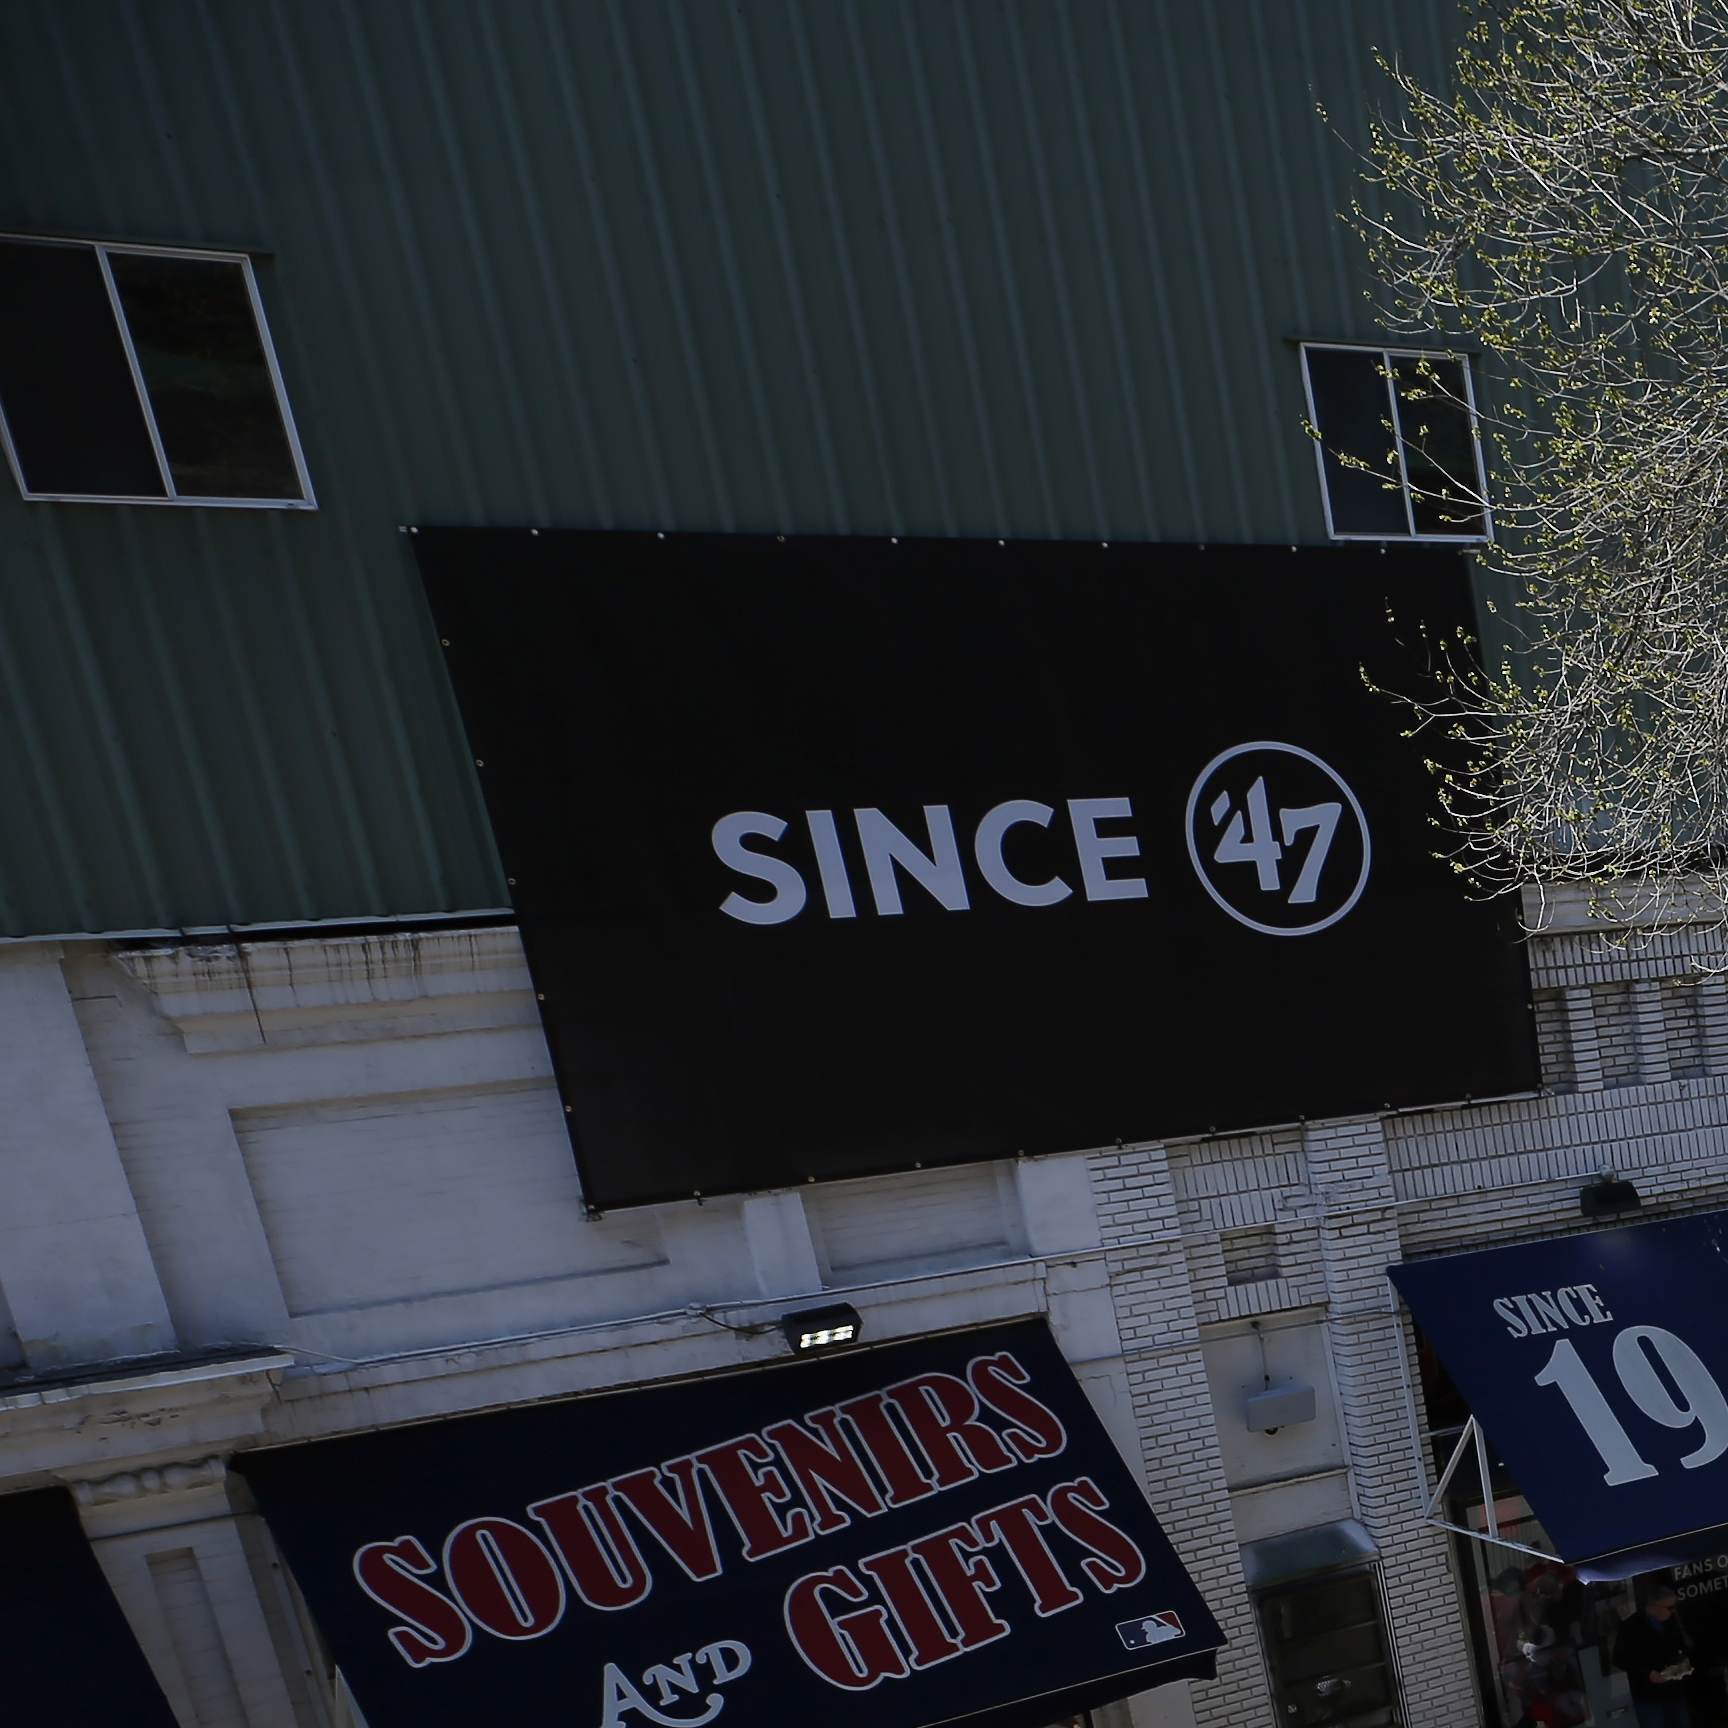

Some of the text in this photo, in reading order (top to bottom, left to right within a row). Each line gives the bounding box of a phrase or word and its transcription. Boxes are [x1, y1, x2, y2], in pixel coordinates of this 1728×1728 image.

[710, 797, 1149, 925] SINCE
[1493, 1284, 1614, 1338] SINCE
[353, 1352, 1067, 1668] SOUVENIRS
[1673, 1556, 1715, 1581] FANS
[783, 1476, 1147, 1690] GIFTS
